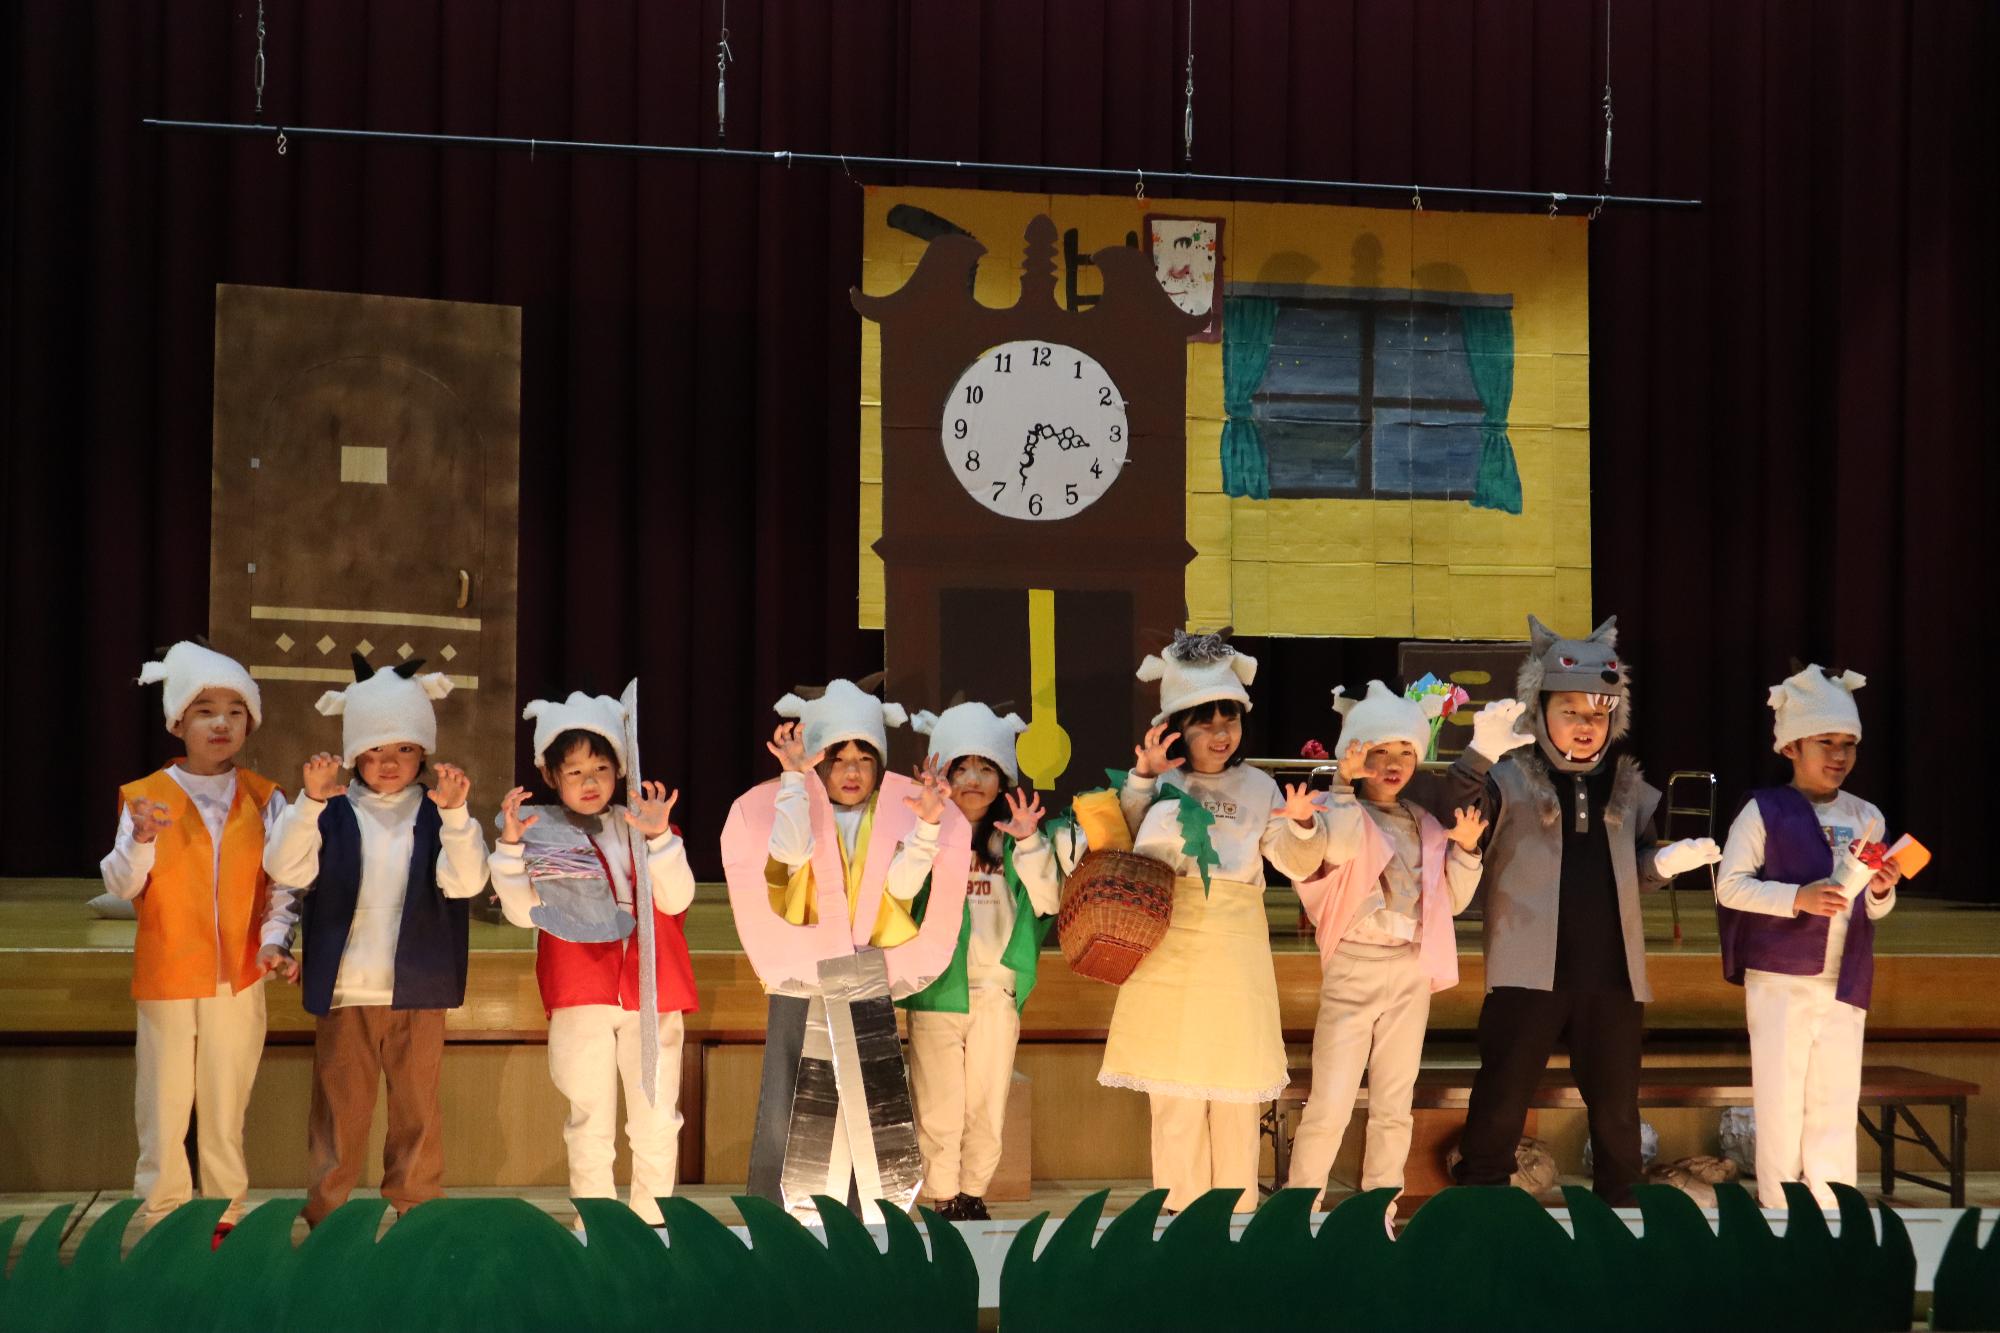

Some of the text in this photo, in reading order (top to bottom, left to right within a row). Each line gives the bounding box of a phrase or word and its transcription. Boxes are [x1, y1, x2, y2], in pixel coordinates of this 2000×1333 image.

[994, 352, 1012, 374] 11
[1031, 346, 1052, 367] 12
[1074, 360, 1082, 380] 1
[965, 385, 984, 404] 10
[1098, 386, 1113, 407] 2
[954, 418, 968, 440] 9
[1109, 424, 1122, 443] 3
[965, 449, 980, 472] 8
[1090, 456, 1103, 480] 4
[991, 481, 1007, 502] 7
[1065, 483, 1079, 506] 5
[1028, 493, 1043, 517] 6
